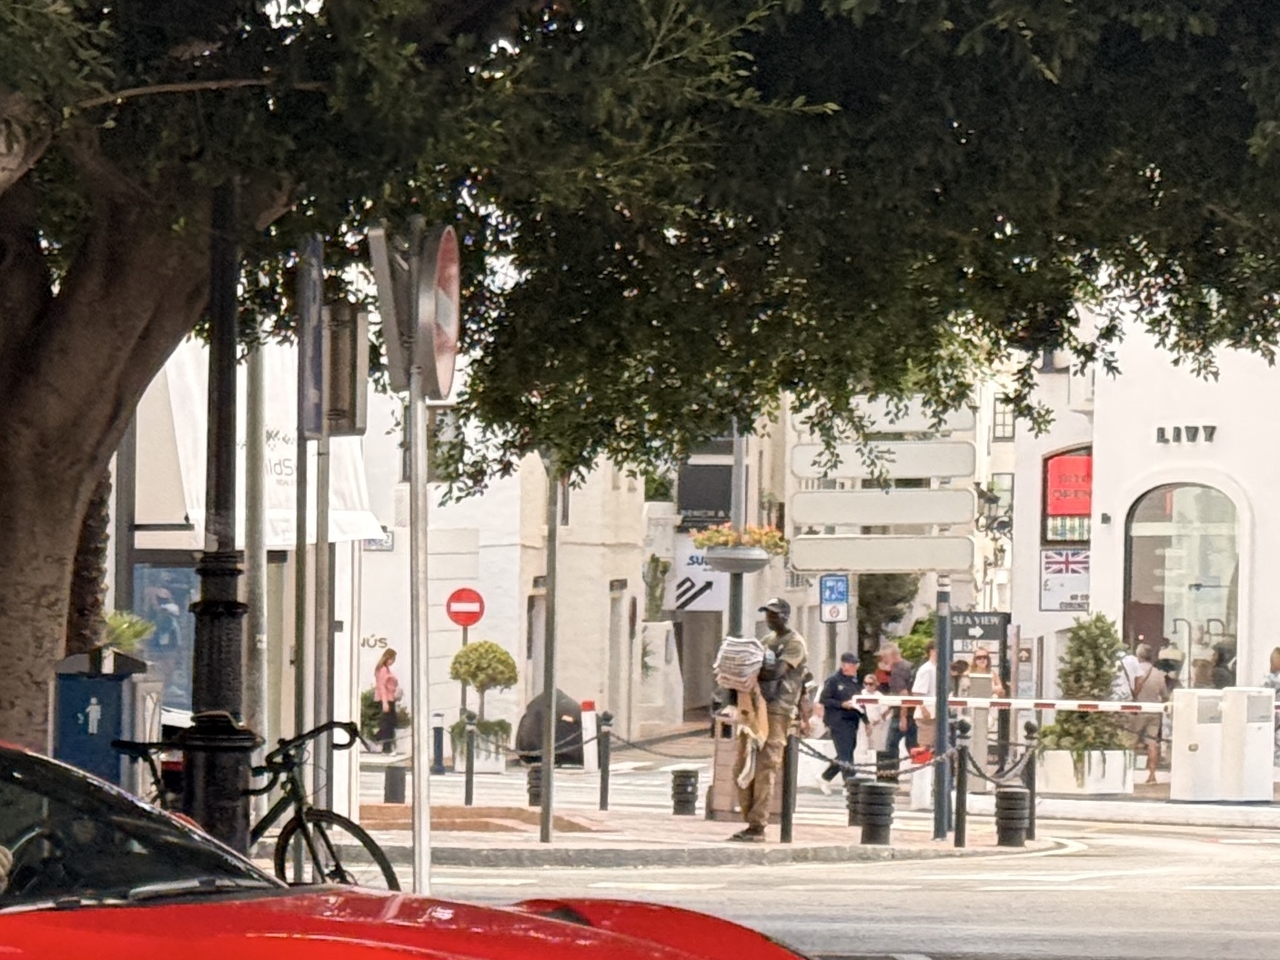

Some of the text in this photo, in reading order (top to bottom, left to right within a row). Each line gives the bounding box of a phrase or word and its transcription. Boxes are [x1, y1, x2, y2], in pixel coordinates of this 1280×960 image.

[1156, 425, 1217, 443] LIVY
[952, 615, 999, 625] SEA VIEW
